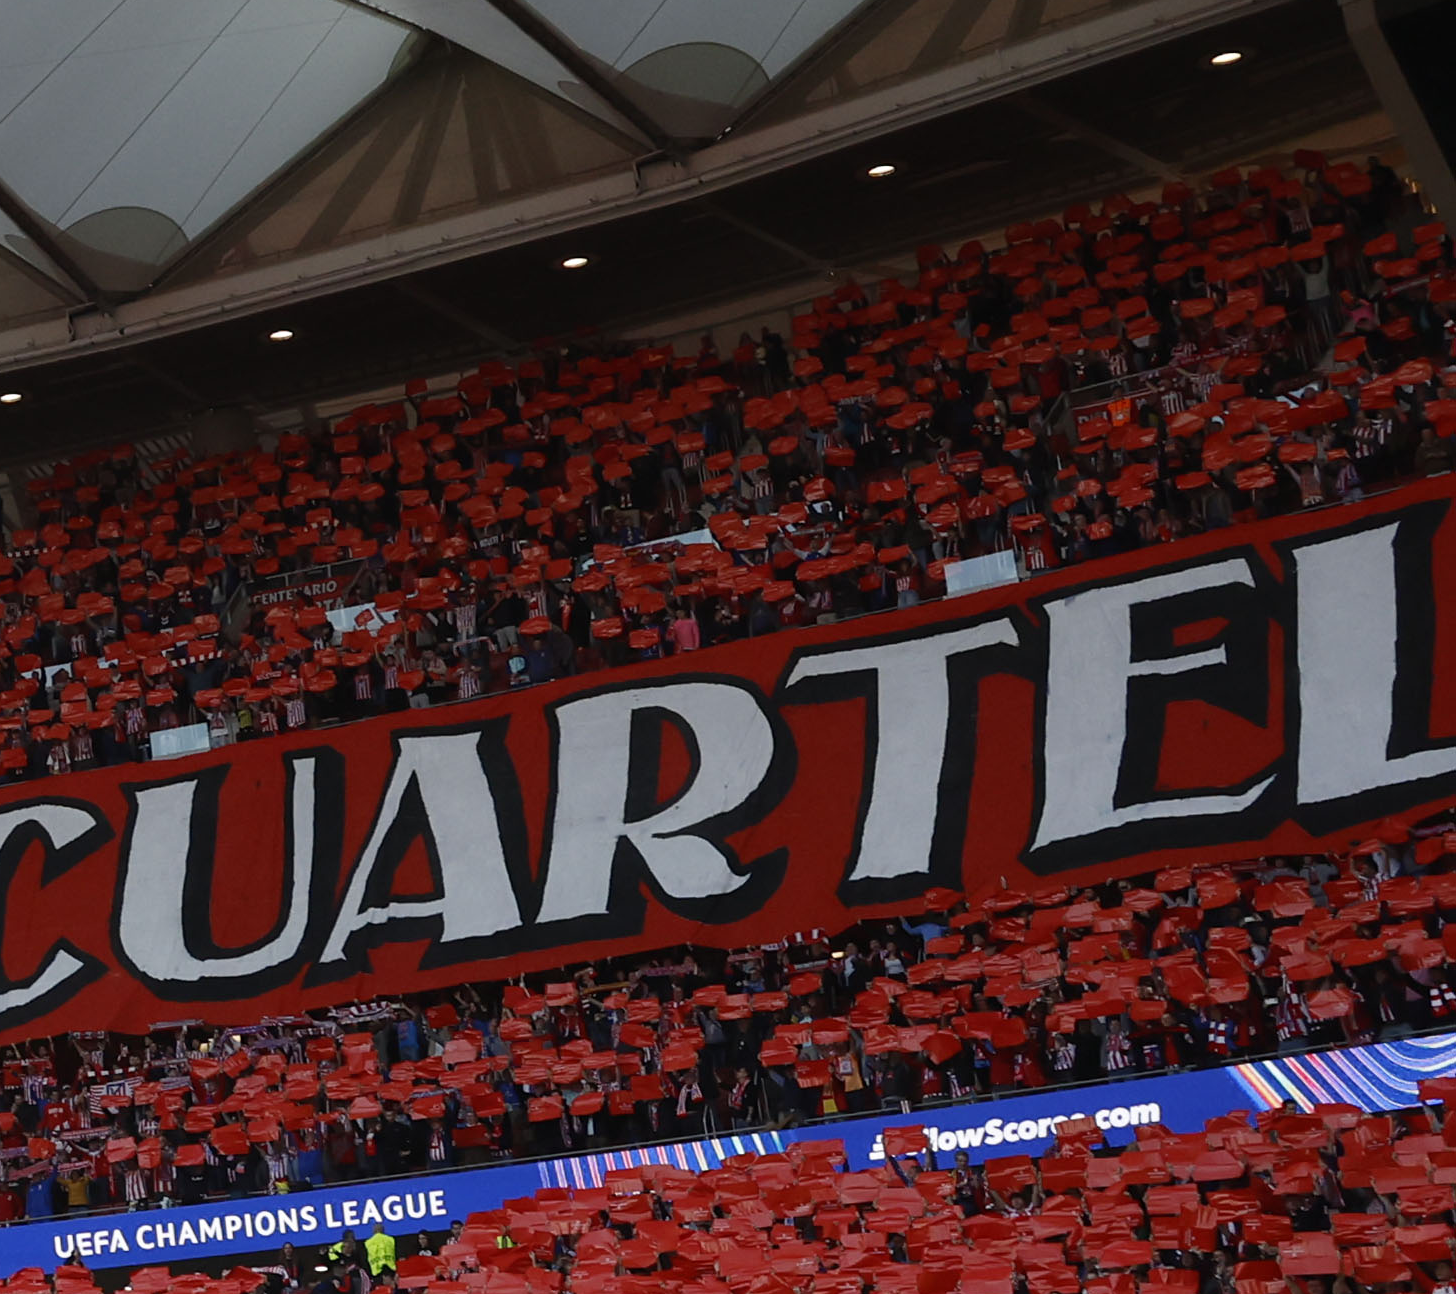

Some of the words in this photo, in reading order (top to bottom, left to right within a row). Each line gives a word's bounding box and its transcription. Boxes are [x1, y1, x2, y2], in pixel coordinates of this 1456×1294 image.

[252, 581, 338, 605] CENTEARIO
[55, 1228, 130, 1258] UEFA
[136, 1206, 318, 1249] CHAMPIONS
[324, 1191, 447, 1227] LEAGUE
